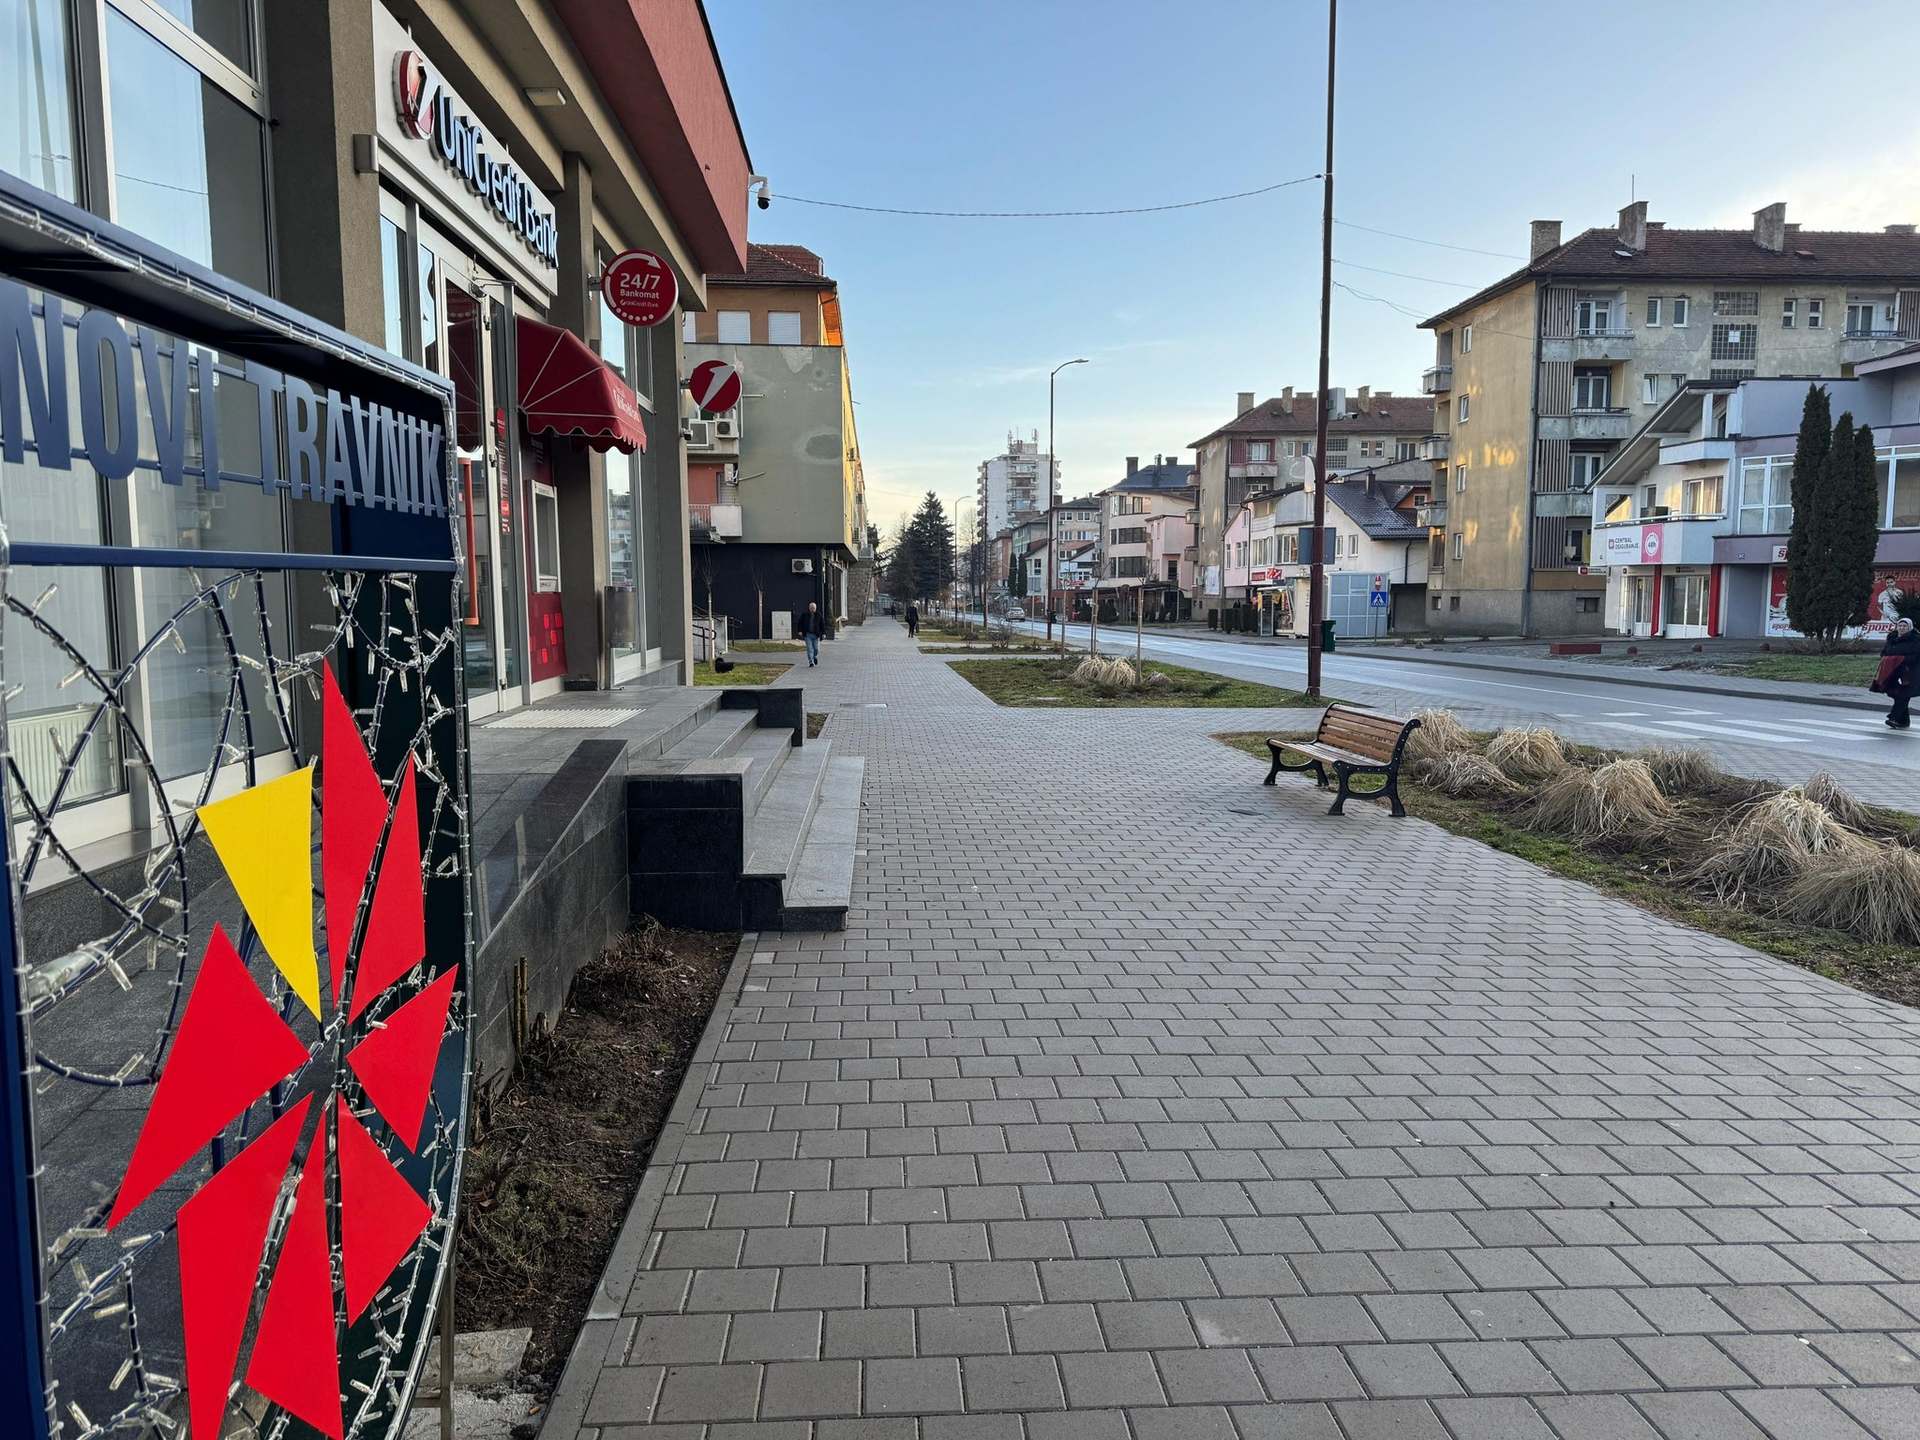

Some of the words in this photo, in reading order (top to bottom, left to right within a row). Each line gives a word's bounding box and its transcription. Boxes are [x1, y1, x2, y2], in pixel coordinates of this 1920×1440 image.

[437, 93, 524, 233] UniCredit
[524, 183, 559, 268] Bank
[619, 272, 660, 290] 24/7
[619, 289, 660, 299] Bankomat
[0, 276, 220, 491] NOVI
[245, 359, 447, 518] TRAVNIK
